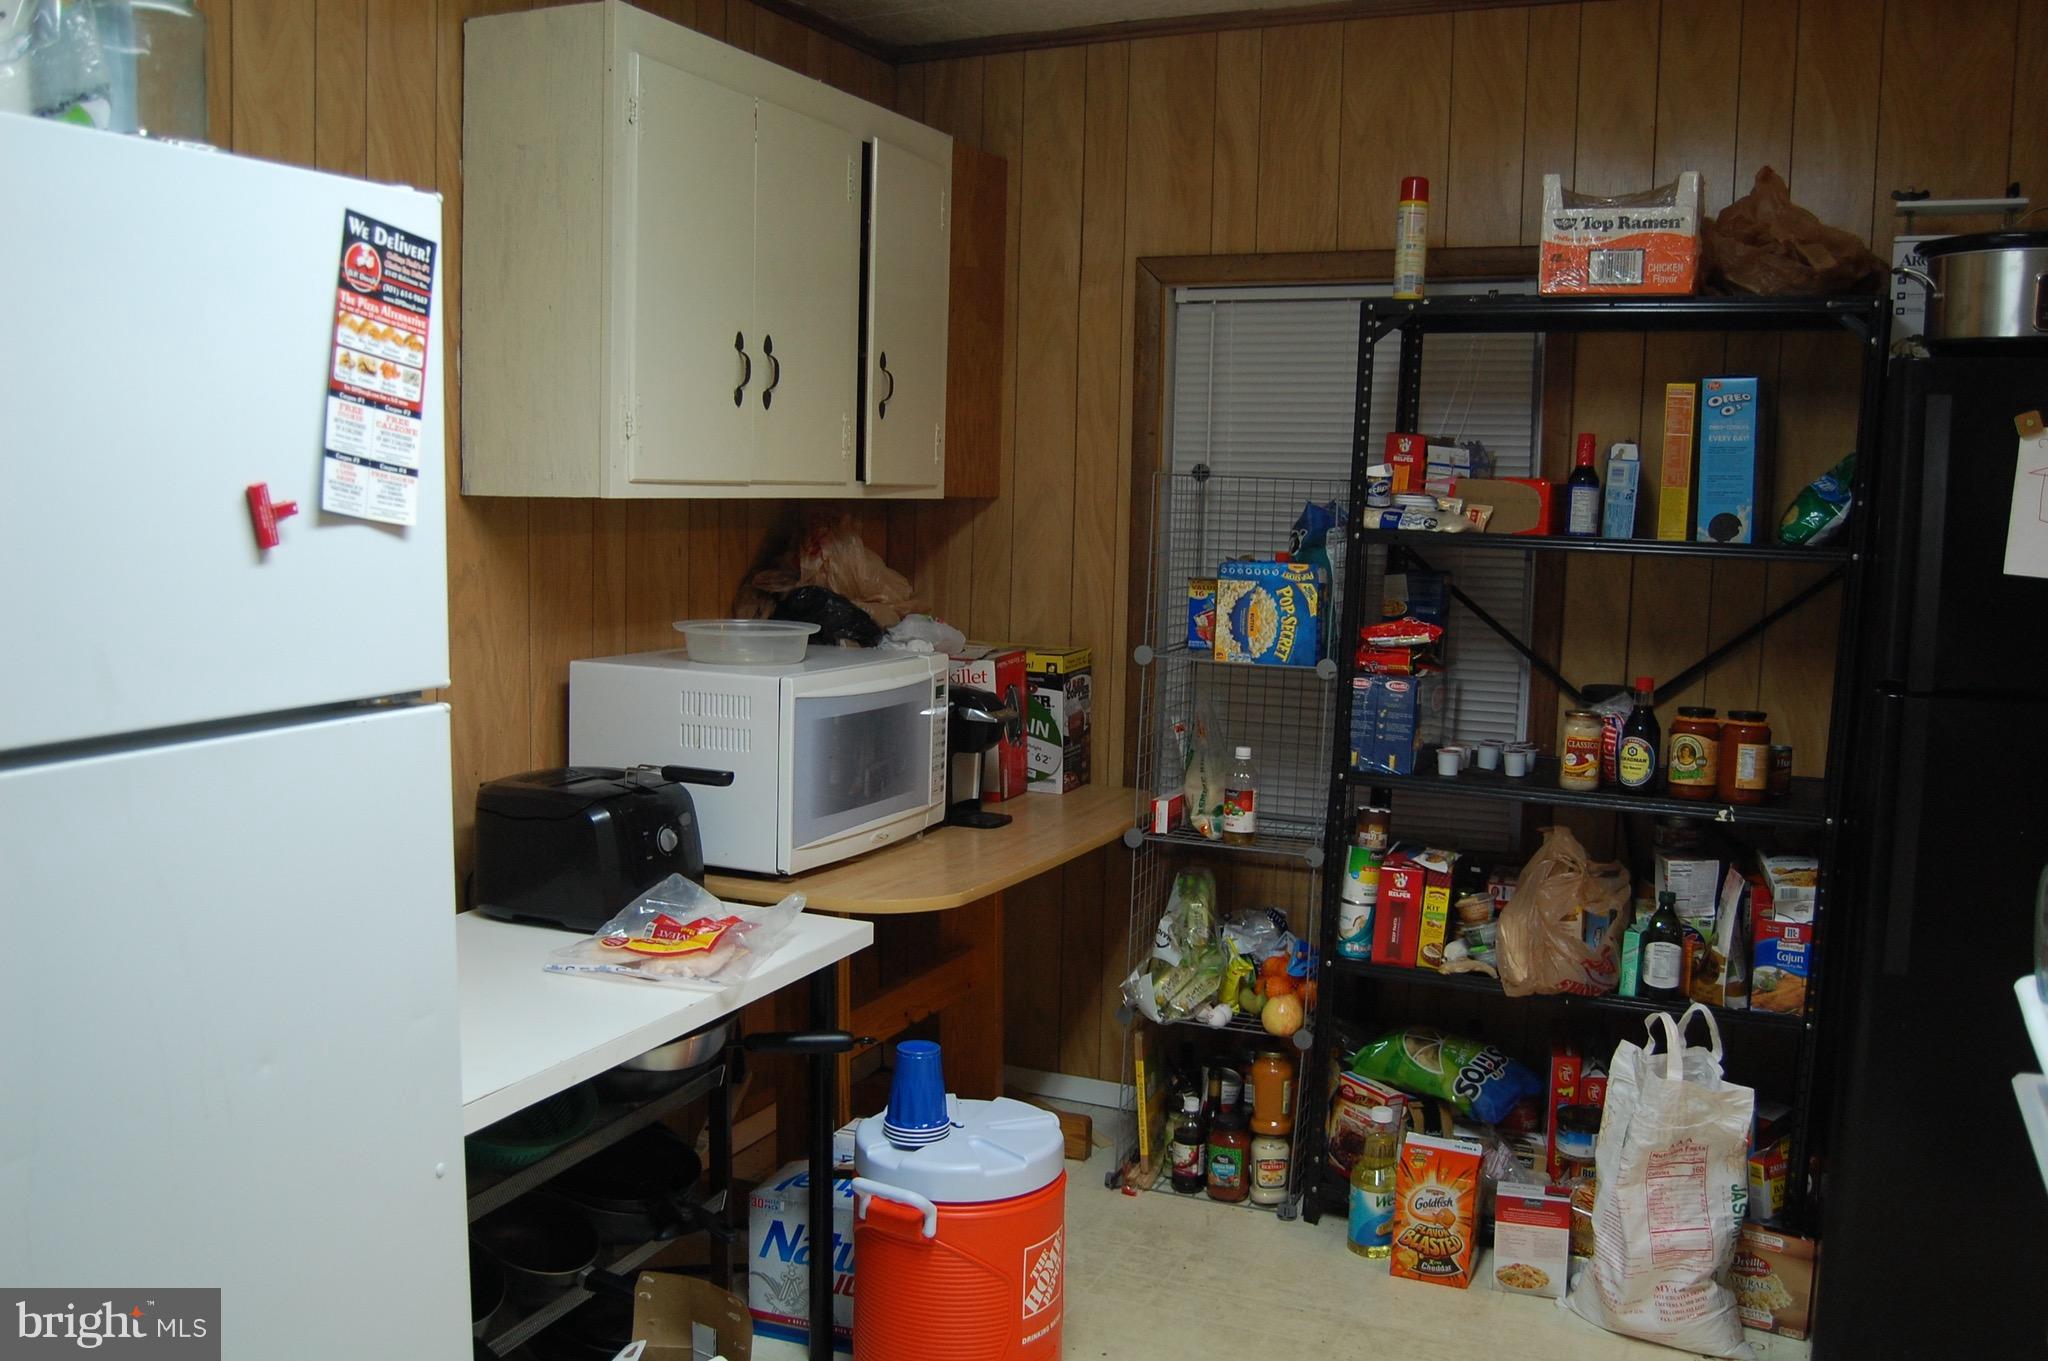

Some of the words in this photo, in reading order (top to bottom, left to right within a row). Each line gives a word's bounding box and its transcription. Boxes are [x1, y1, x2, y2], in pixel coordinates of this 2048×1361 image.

[1581, 217, 1614, 232] Top
[1618, 216, 1682, 230] Ramen
[1648, 263, 1684, 273] CHICKEN
[1651, 274, 1678, 283] Flavor
[1708, 393, 1751, 407] OREO
[1776, 951, 1804, 964] Cajun
[752, 1197, 764, 1208] 30
[1414, 1197, 1453, 1210] Goldfish
[1415, 1224, 1450, 1238] FLAVOR
[1402, 1230, 1462, 1258] BLASTED
[1025, 1228, 1062, 1312] HOME
[1030, 1248, 1049, 1280] THE
[1421, 1261, 1453, 1272] Cheddar
[1021, 1324, 1050, 1345] DRINKING
